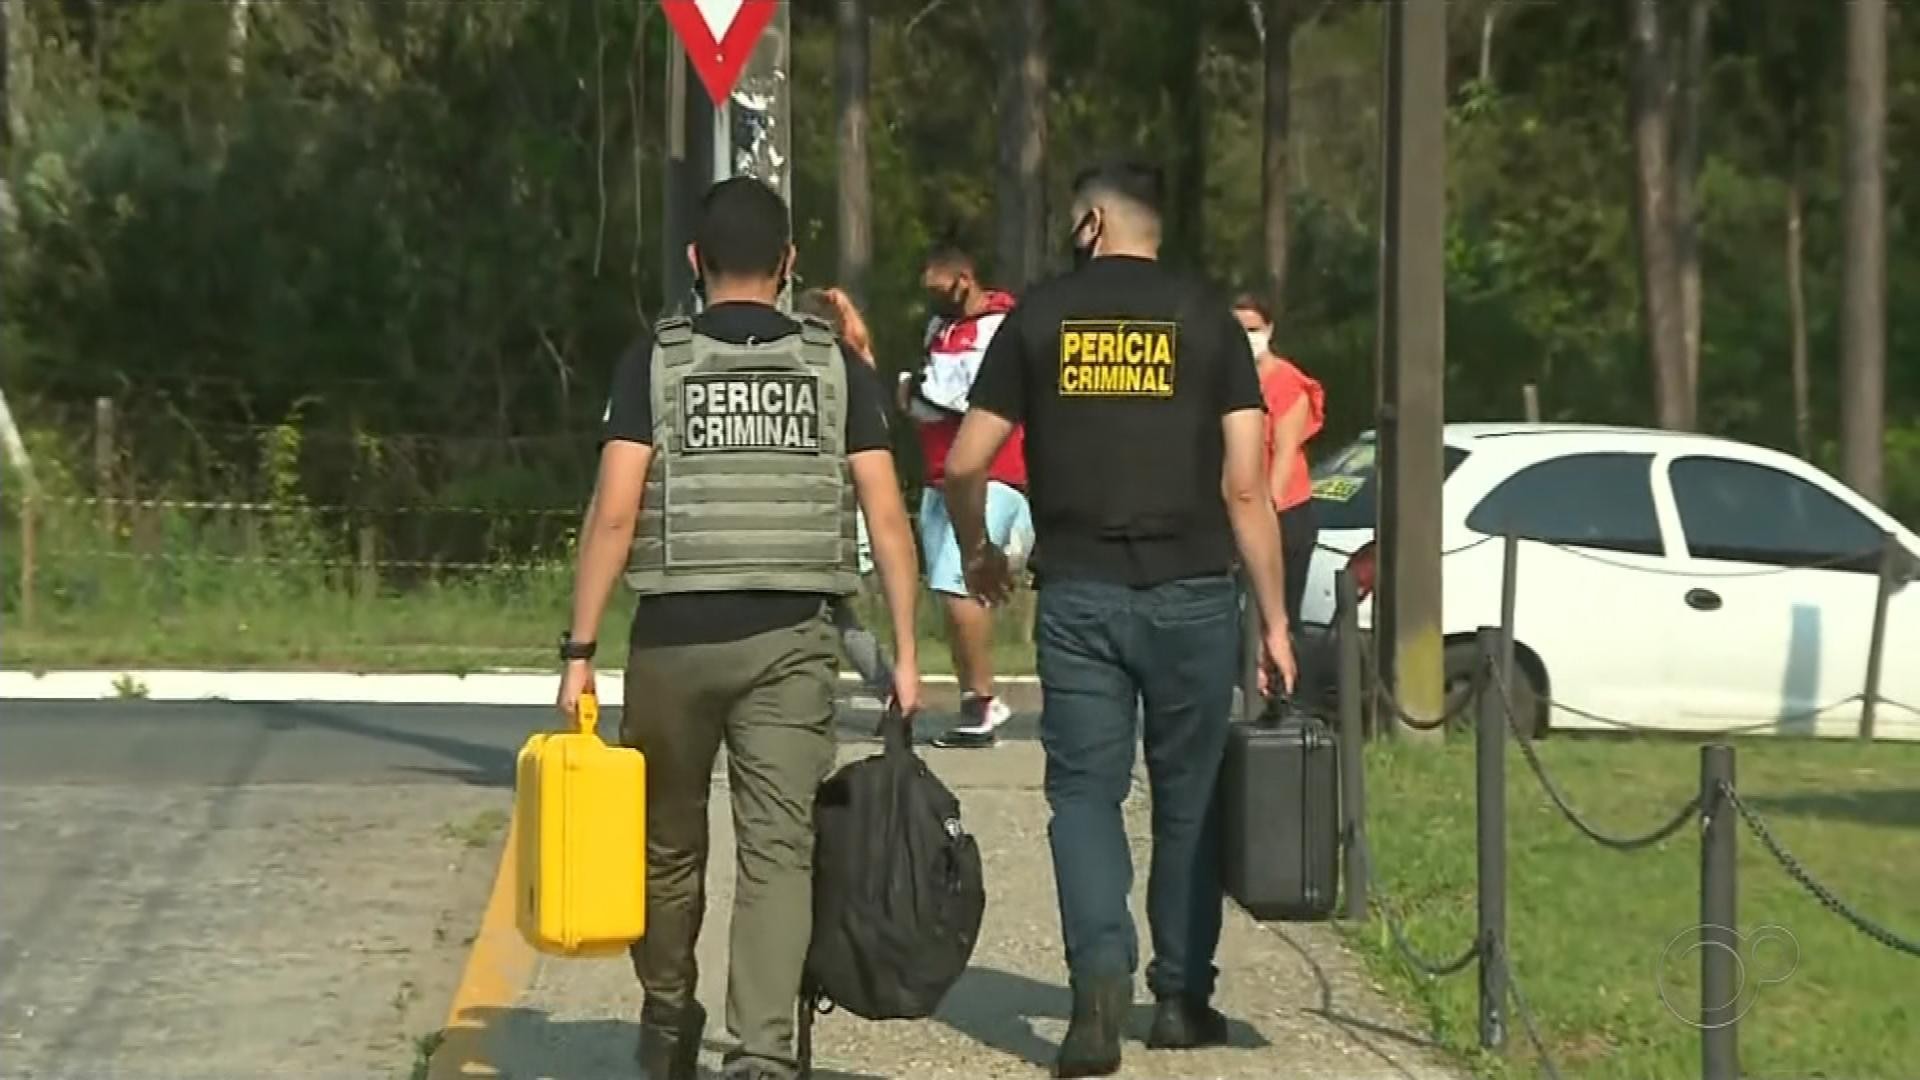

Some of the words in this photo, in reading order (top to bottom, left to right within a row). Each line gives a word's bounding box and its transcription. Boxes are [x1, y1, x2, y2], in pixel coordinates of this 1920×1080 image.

[1063, 325, 1171, 364] PERÍCIA
[1063, 365, 1170, 391] CRIMINAL
[687, 415, 817, 447] CRIMINAL
